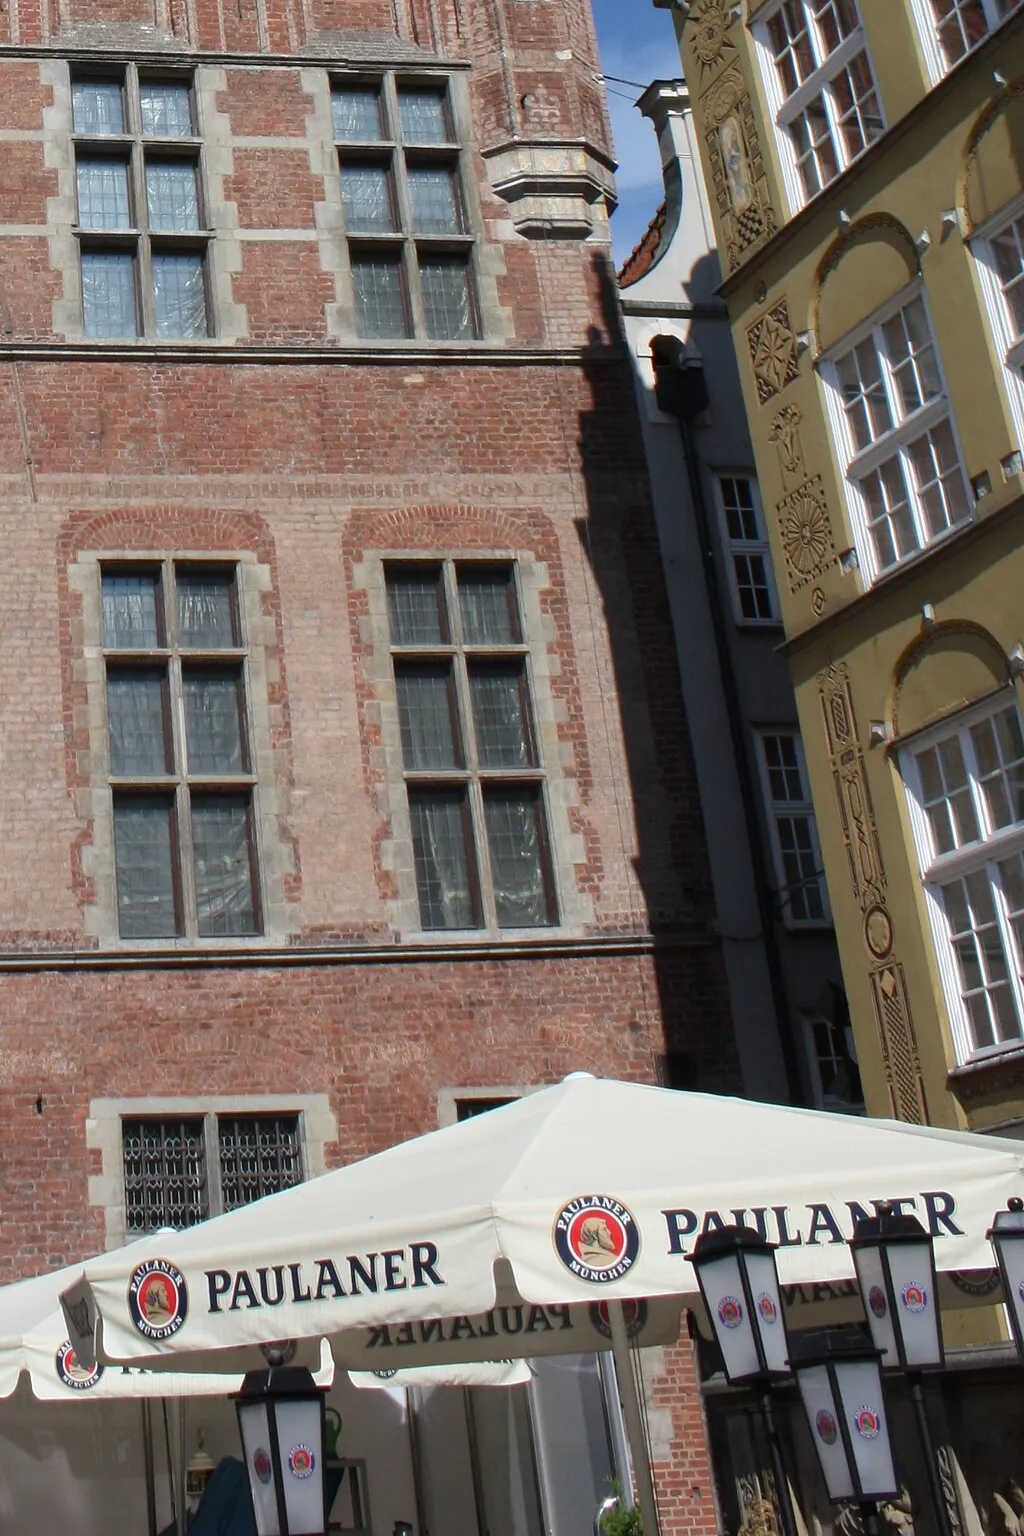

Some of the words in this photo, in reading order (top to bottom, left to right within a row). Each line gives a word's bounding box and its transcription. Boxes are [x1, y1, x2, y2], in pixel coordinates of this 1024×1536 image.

[557, 1196, 631, 1231] PAULANER
[131, 1260, 183, 1293] PAULANER
[204, 1241, 445, 1314] PAULANER
[569, 1256, 632, 1281] MÜNCHEN
